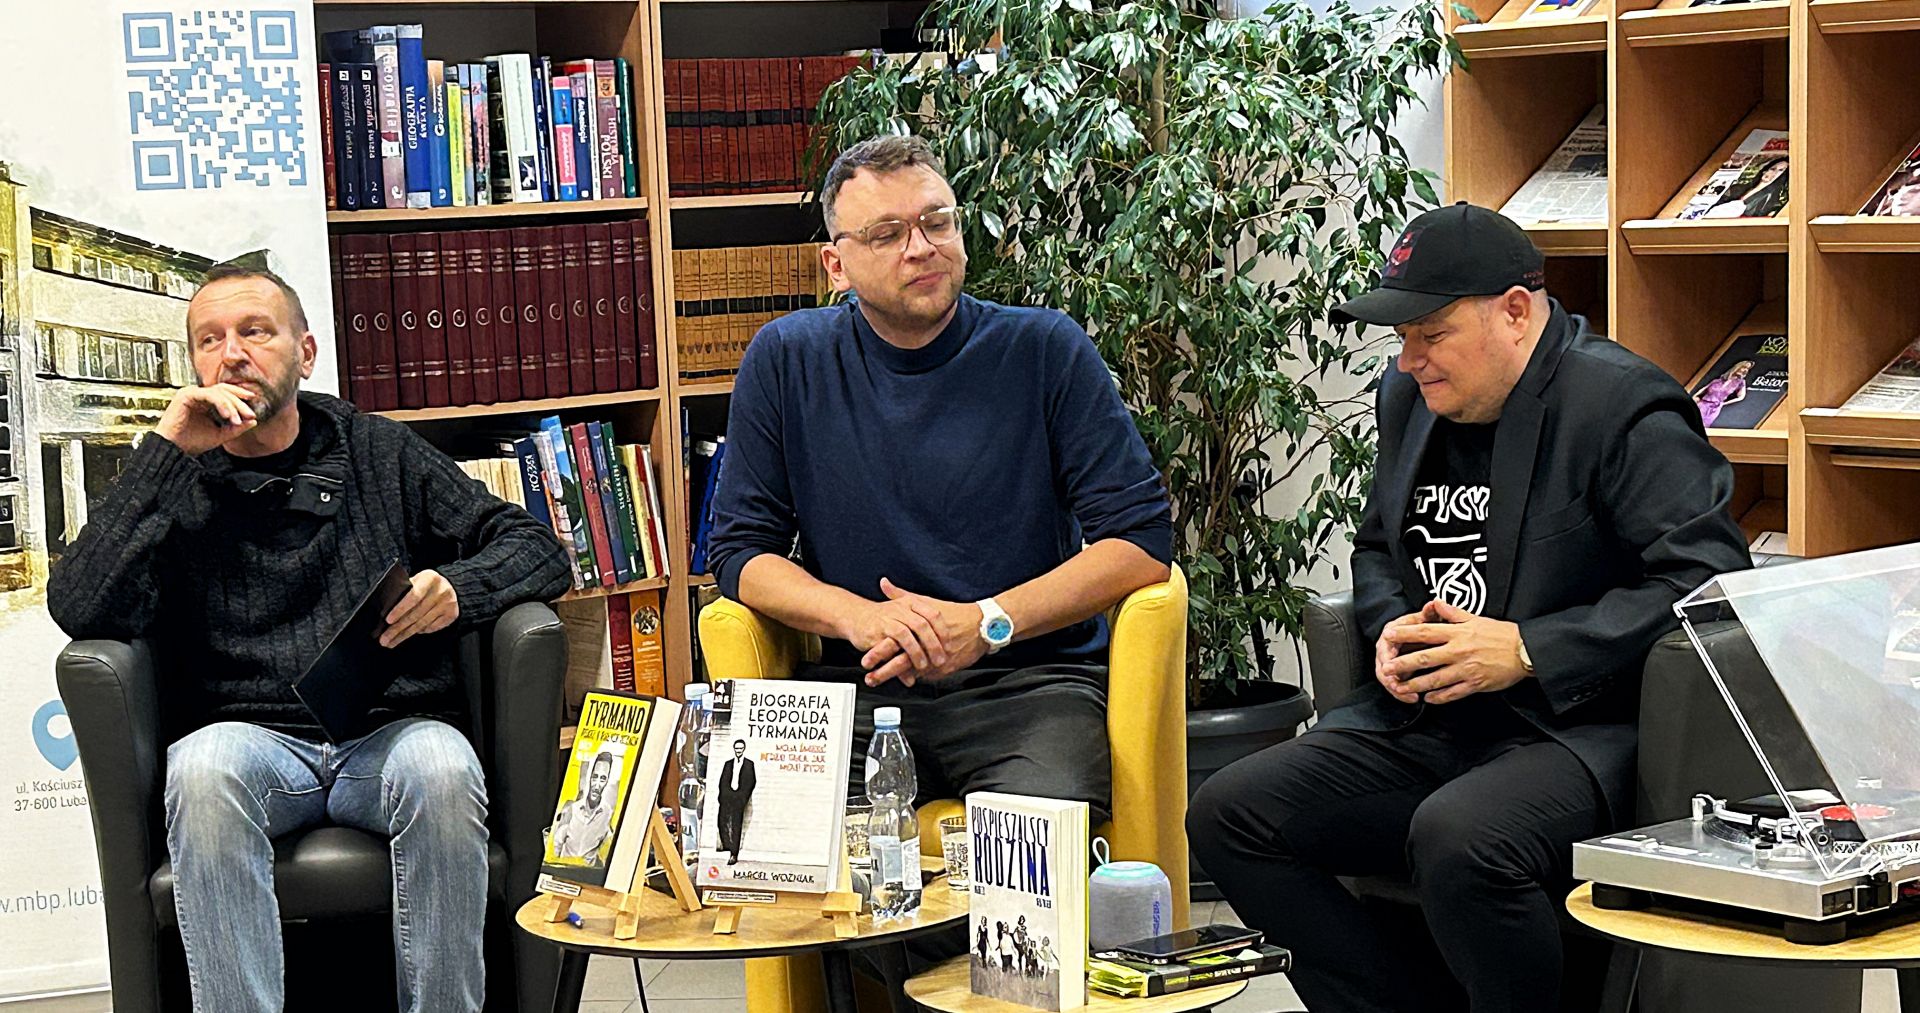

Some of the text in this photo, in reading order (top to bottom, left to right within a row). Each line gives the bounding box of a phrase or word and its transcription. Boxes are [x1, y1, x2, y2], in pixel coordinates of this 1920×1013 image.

[600, 134, 613, 179] POLSKI
[750, 693, 830, 709] BIOGRAFIA
[586, 700, 645, 734] TYRMAND
[748, 708, 829, 724] LEOPOLDA
[748, 724, 828, 740] TYRMANDA
[33, 779, 83, 792] Kościusz
[14, 795, 87, 812] 37-600 Luba
[974, 833, 1050, 896] RODZINA
[732, 870, 768, 881] MARCEL
